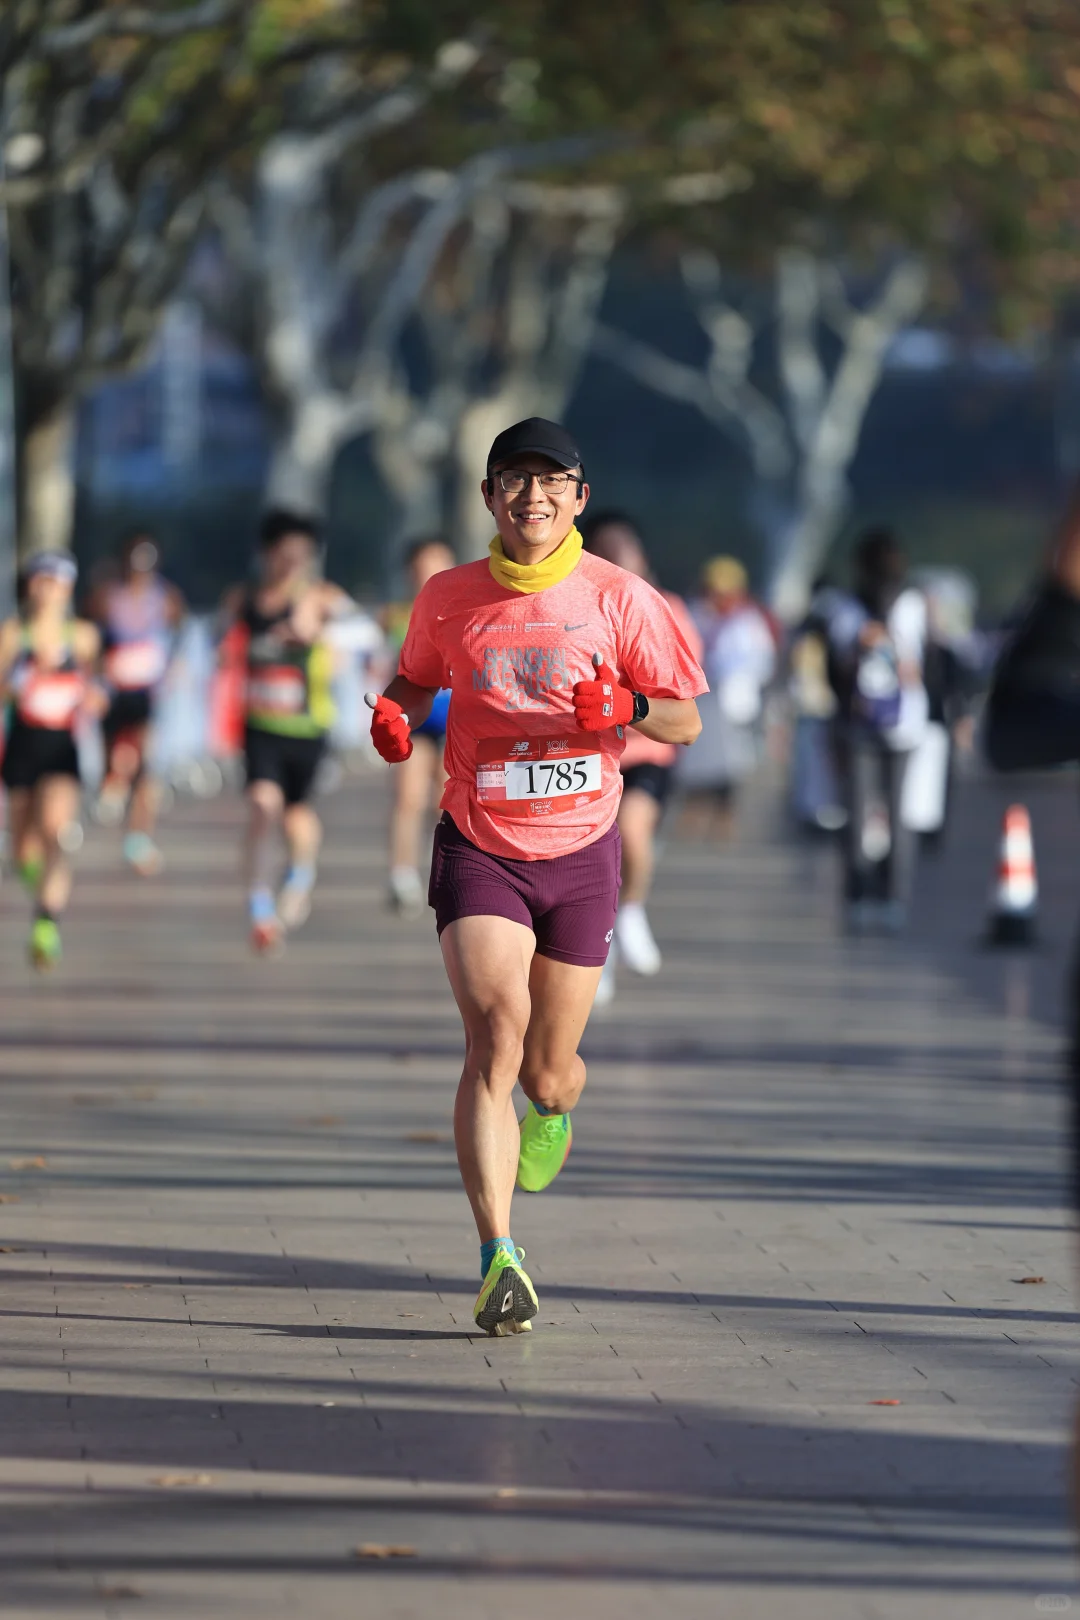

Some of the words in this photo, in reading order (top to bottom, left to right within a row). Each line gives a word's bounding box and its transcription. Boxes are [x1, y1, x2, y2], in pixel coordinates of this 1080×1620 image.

[484, 647, 566, 670] SHANGHAI
[472, 668, 579, 692] MARATHON
[525, 760, 588, 794] 1785
